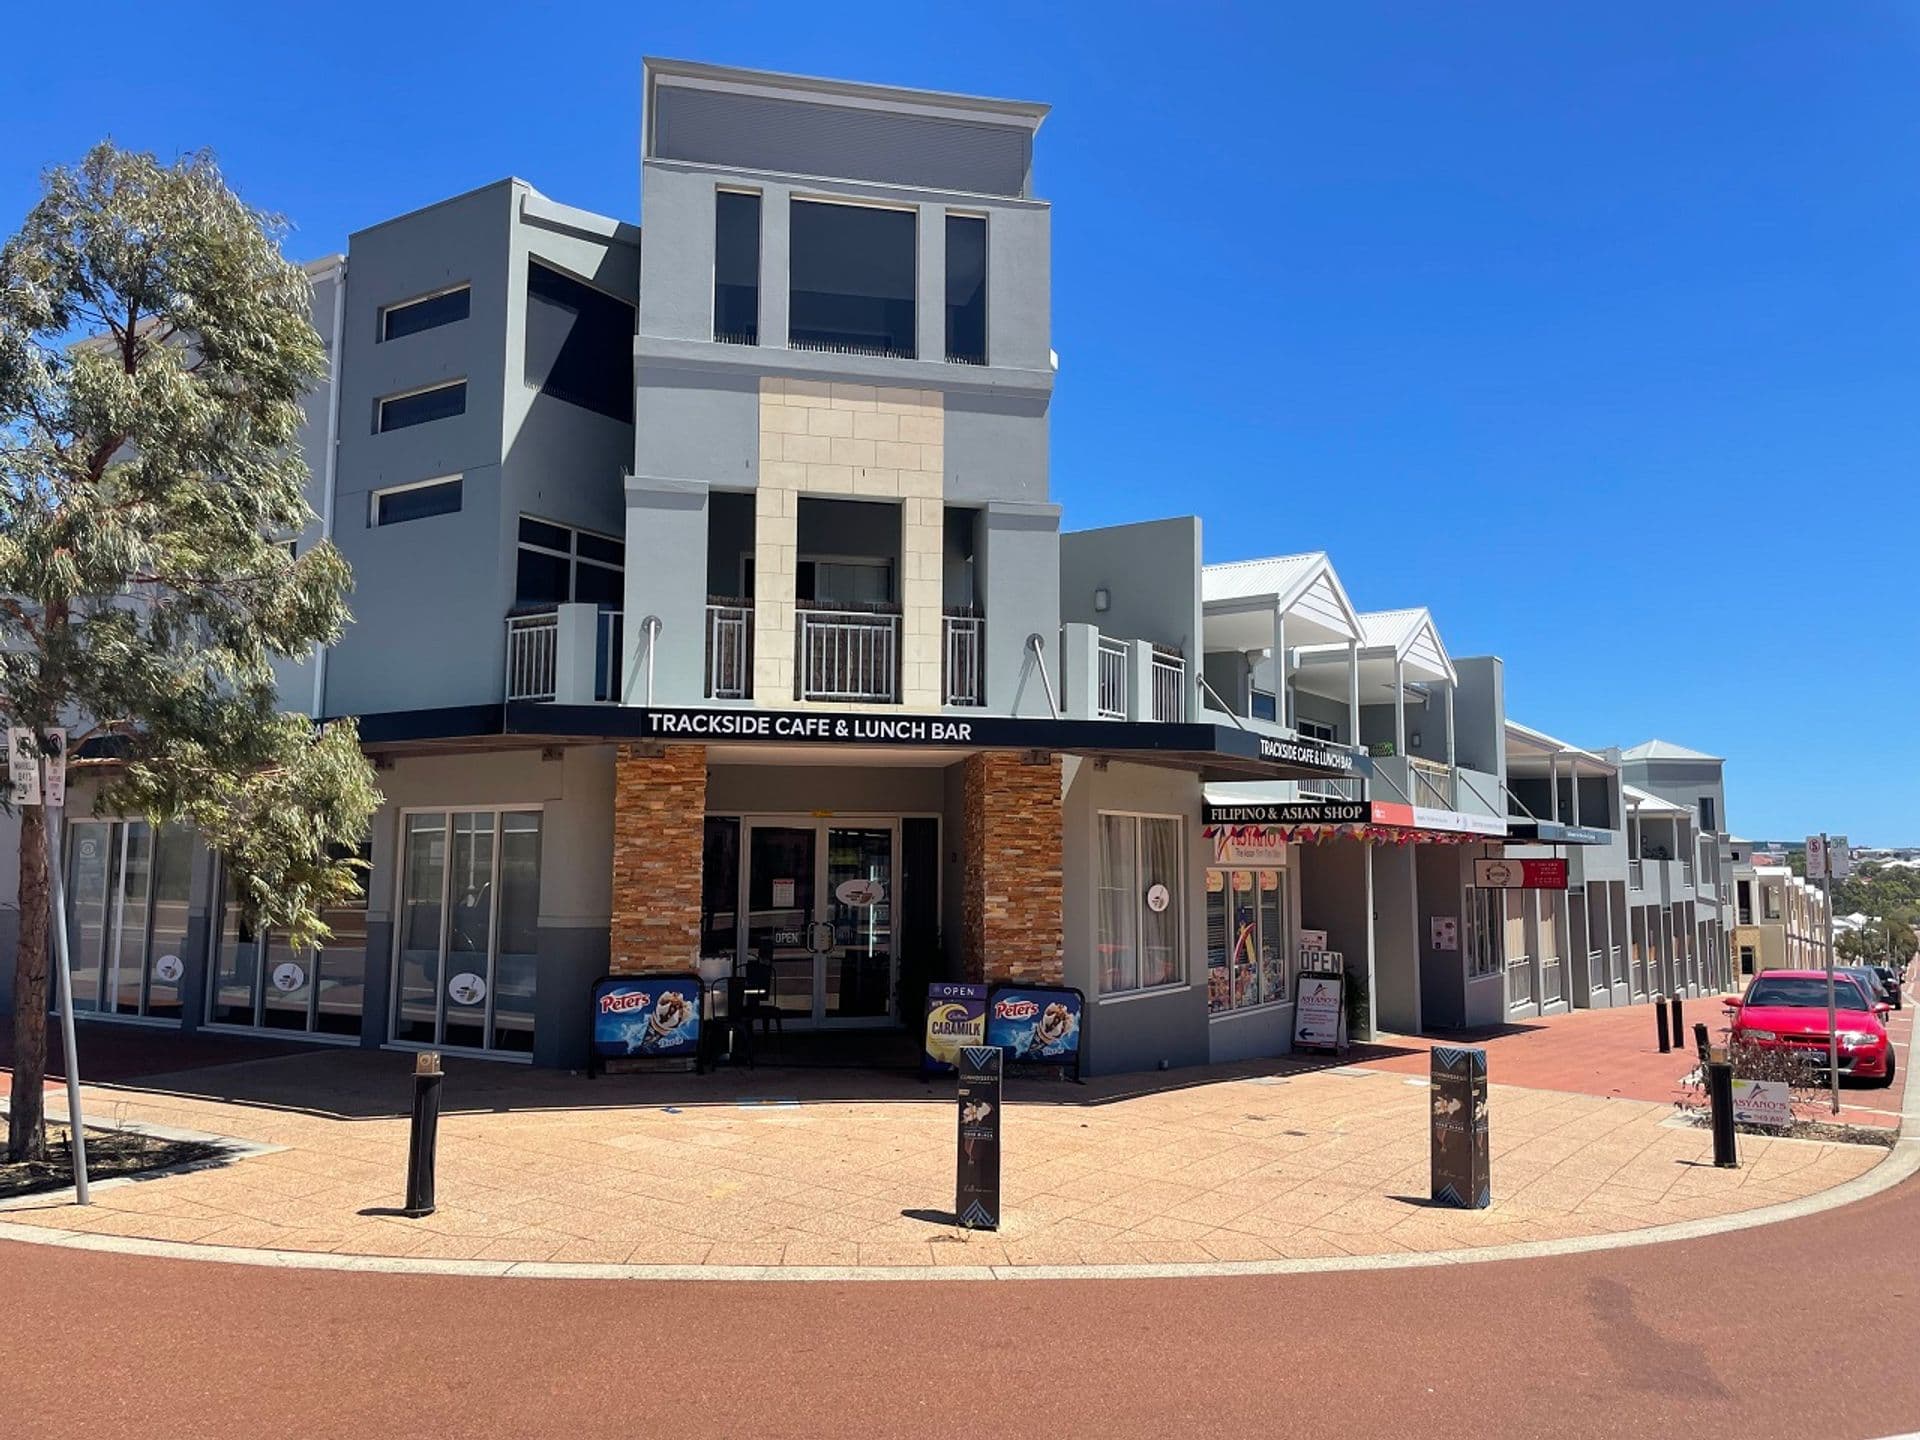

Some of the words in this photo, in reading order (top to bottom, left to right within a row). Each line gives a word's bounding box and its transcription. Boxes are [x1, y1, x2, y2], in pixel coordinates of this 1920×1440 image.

[648, 713, 770, 734] TRACKSIDE
[775, 717, 830, 736] CAFE
[835, 719, 849, 737] &
[854, 720, 925, 739] LUNCH
[931, 723, 971, 740] BAR
[1260, 739, 1297, 760] TRACKSIDE
[1297, 747, 1314, 764] CAFE
[1314, 750, 1320, 765] &
[1320, 751, 1340, 768] LUNCH
[1341, 755, 1353, 770] BAR
[1211, 808, 1266, 820] FILIPINO
[1267, 808, 1277, 820] &
[1281, 807, 1320, 820] ASIAN
[1324, 805, 1363, 819] SHOP
[776, 932, 799, 943] OPEN
[1300, 951, 1341, 973] OPEN
[943, 986, 975, 996] OPEN
[600, 992, 650, 1013] Peters
[995, 1000, 1039, 1019] Peters
[931, 1021, 981, 1036] CARAMILK
[1734, 1098, 1787, 1110] ASYANO'S
